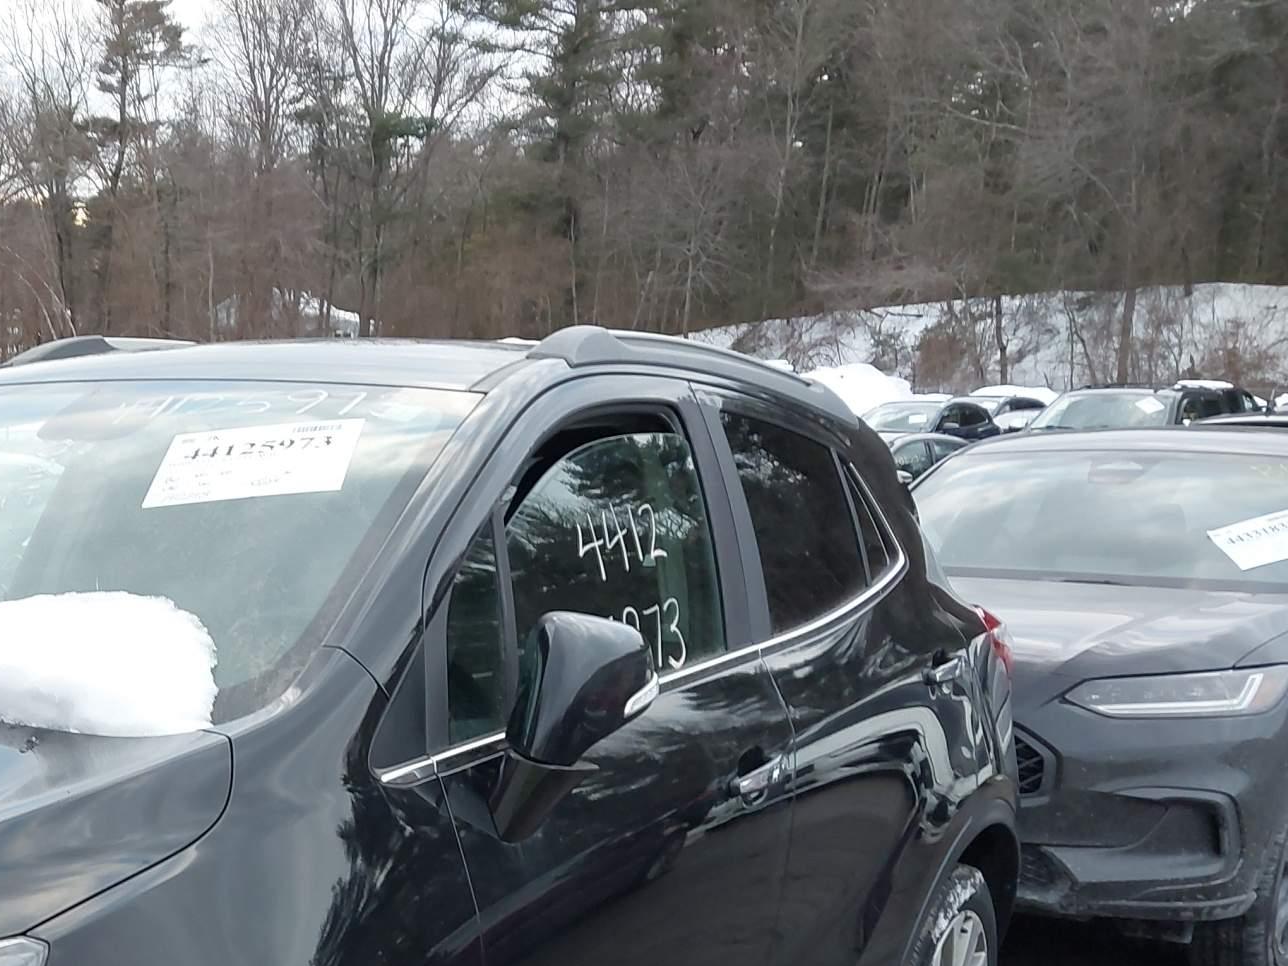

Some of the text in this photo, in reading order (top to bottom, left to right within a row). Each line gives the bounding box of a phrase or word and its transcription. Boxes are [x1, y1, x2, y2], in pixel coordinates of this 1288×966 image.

[183, 434, 335, 460] 44125973
[576, 502, 668, 582] 4412
[608, 597, 687, 669] 73
